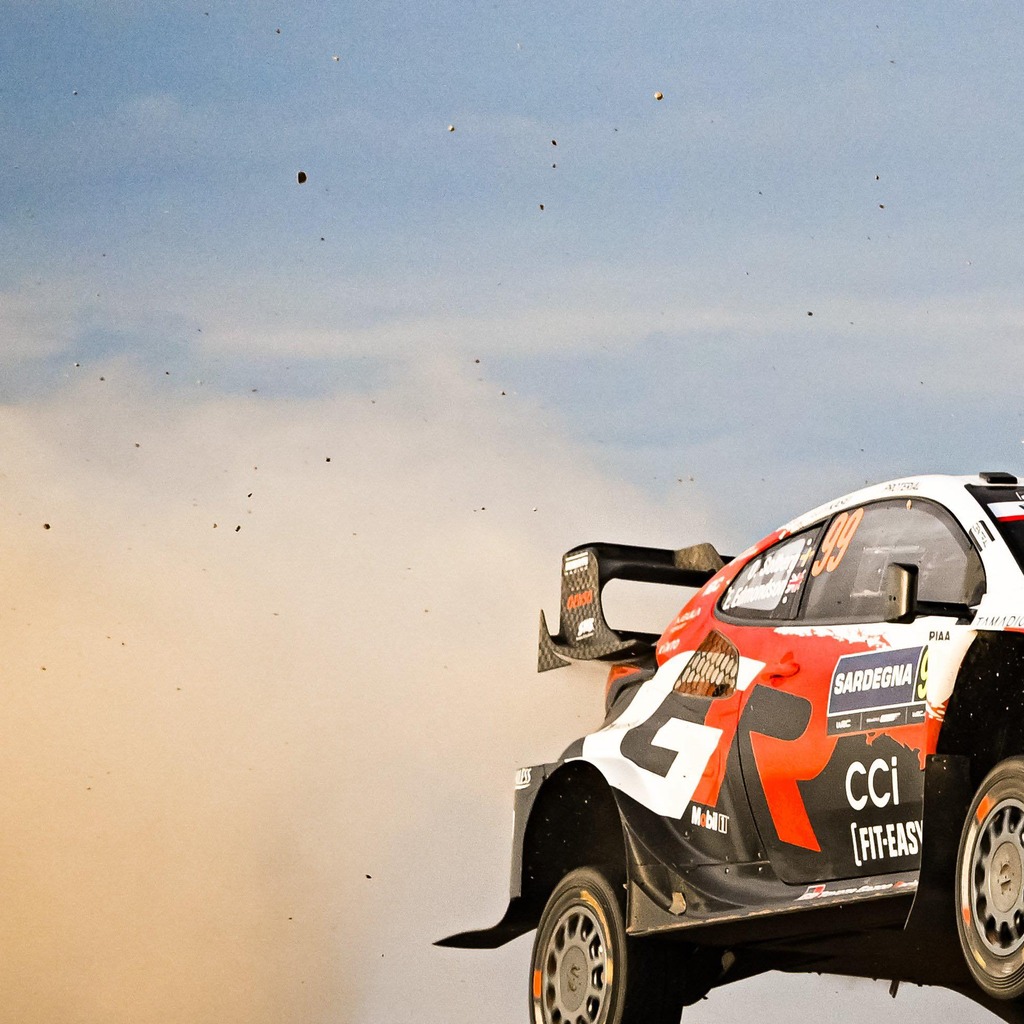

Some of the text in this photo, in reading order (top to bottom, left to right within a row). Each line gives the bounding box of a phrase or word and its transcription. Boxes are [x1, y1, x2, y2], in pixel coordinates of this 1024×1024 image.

[812, 508, 864, 577] 99
[834, 664, 912, 694] SARDEGNA
[845, 756, 900, 810] CCi
[691, 806, 718, 831] Mobil
